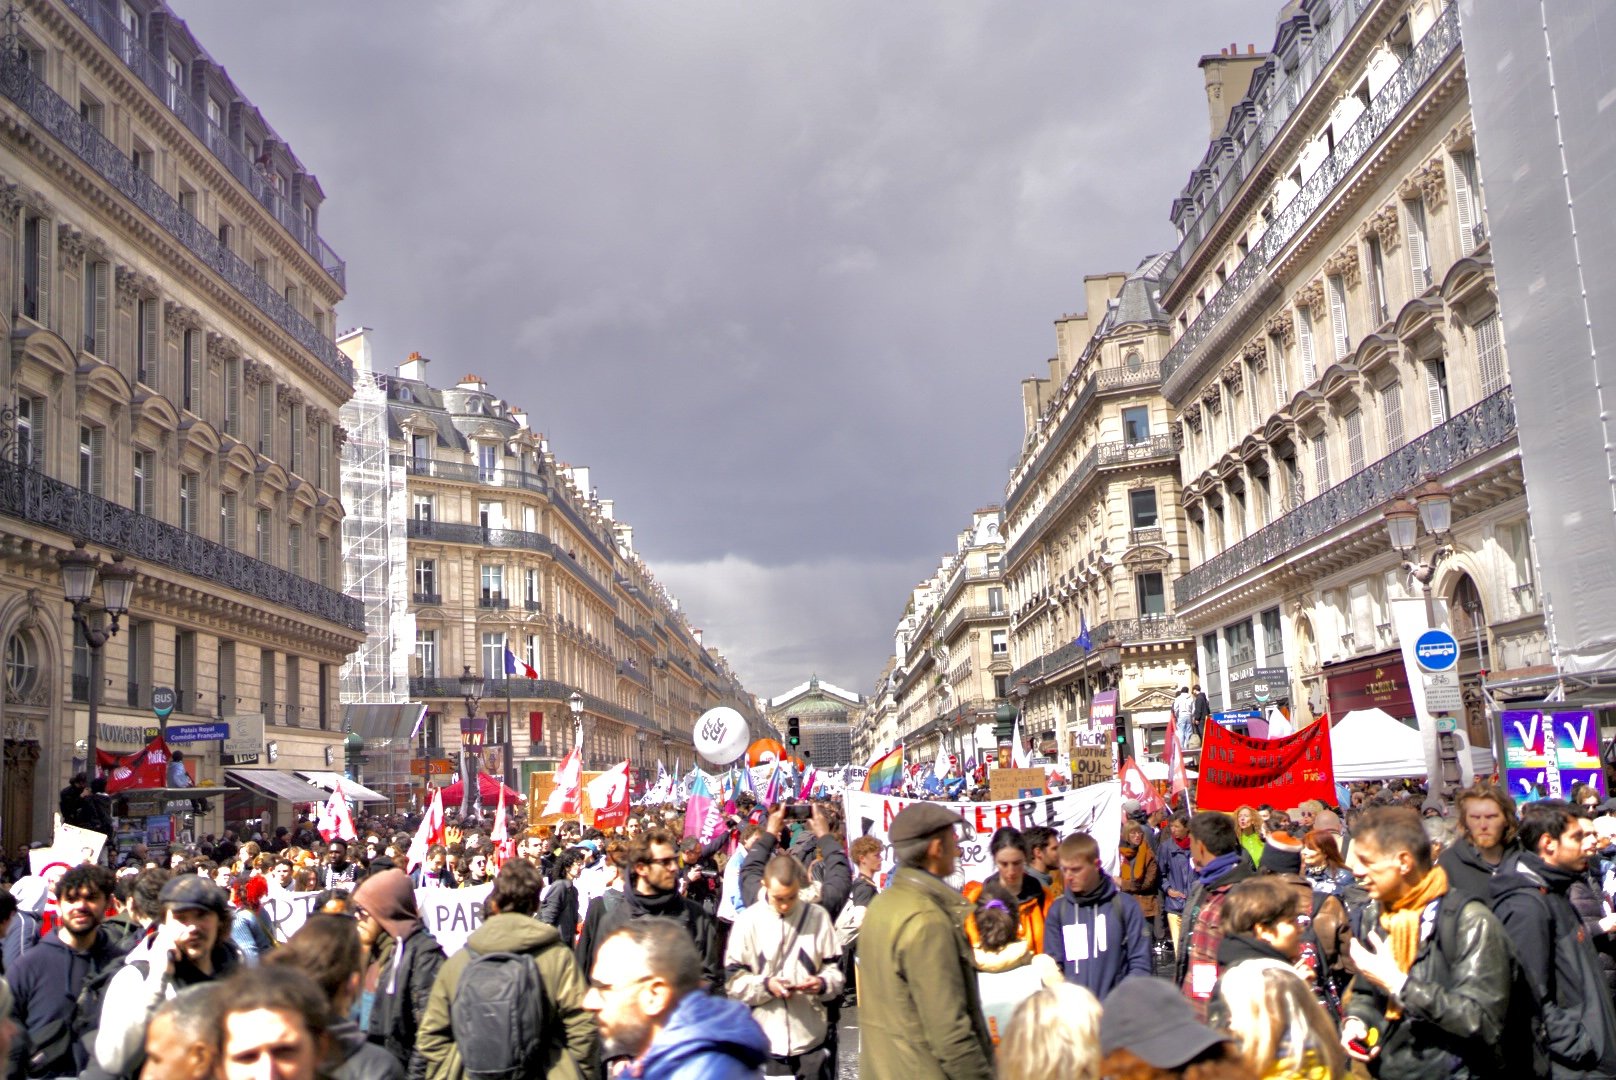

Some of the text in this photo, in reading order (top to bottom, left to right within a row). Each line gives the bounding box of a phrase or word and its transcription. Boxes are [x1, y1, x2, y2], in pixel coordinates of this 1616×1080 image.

[1254, 684, 1268, 692] BUS
[154, 693, 172, 703] BUS
[181, 725, 215, 734] Palais Royal
[709, 717, 724, 741] CGC
[170, 732, 224, 741] Comédie Française
